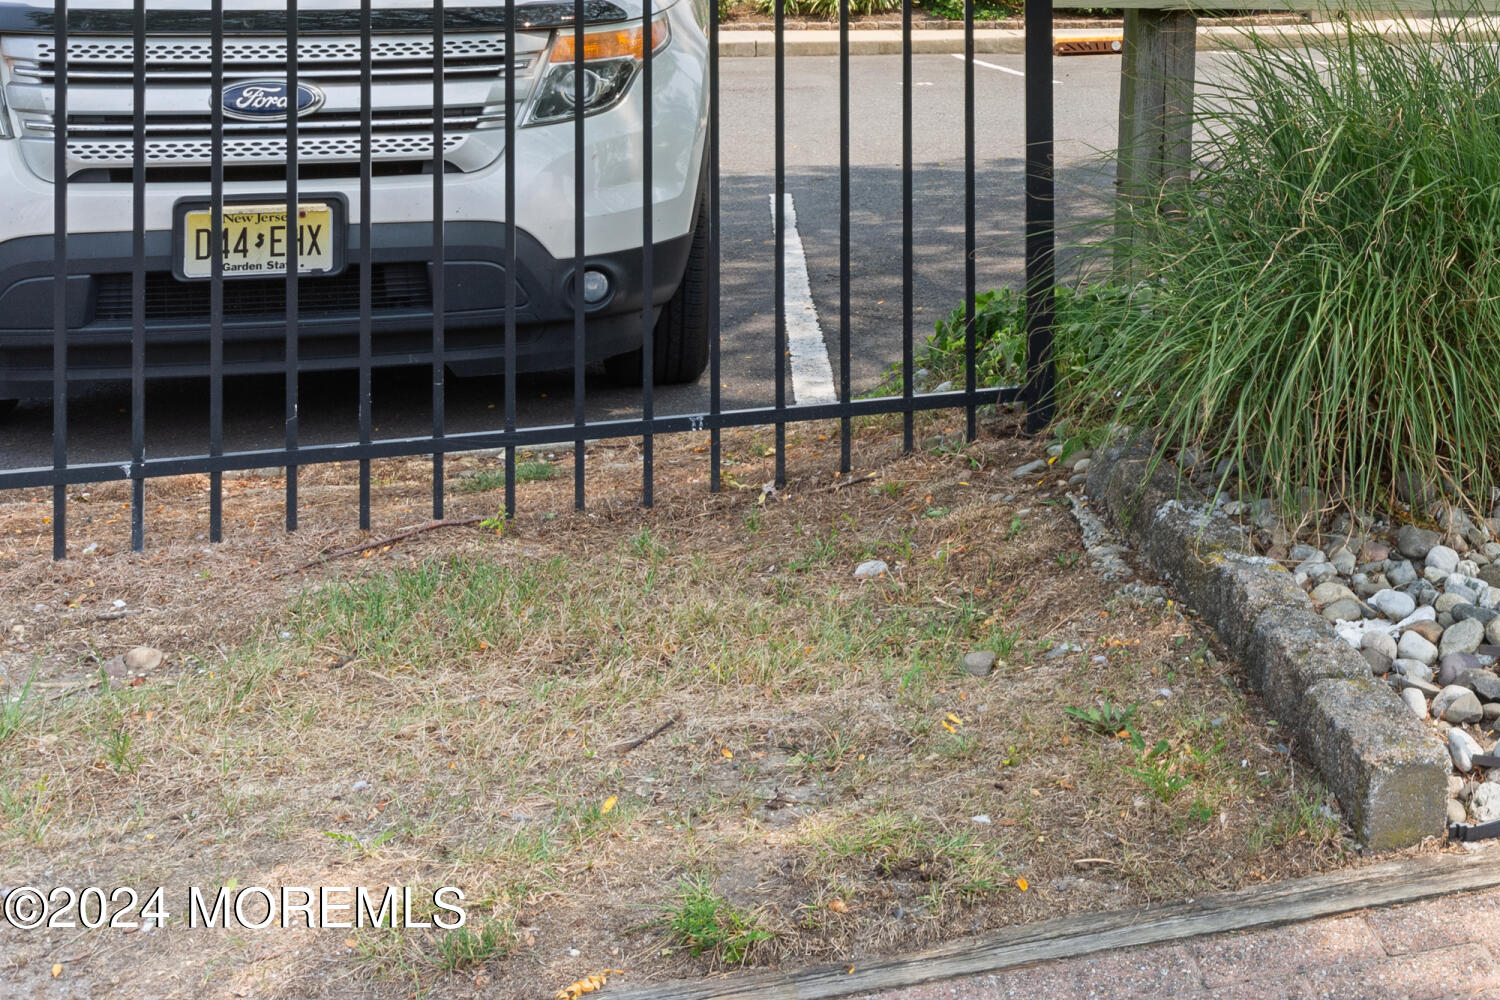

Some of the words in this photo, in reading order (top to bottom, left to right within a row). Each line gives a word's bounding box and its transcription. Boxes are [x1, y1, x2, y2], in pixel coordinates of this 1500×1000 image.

[223, 213, 252, 223] New
[255, 213, 288, 224] Jerse
[223, 262, 262, 271] Garden
[267, 261, 287, 270] Sta
